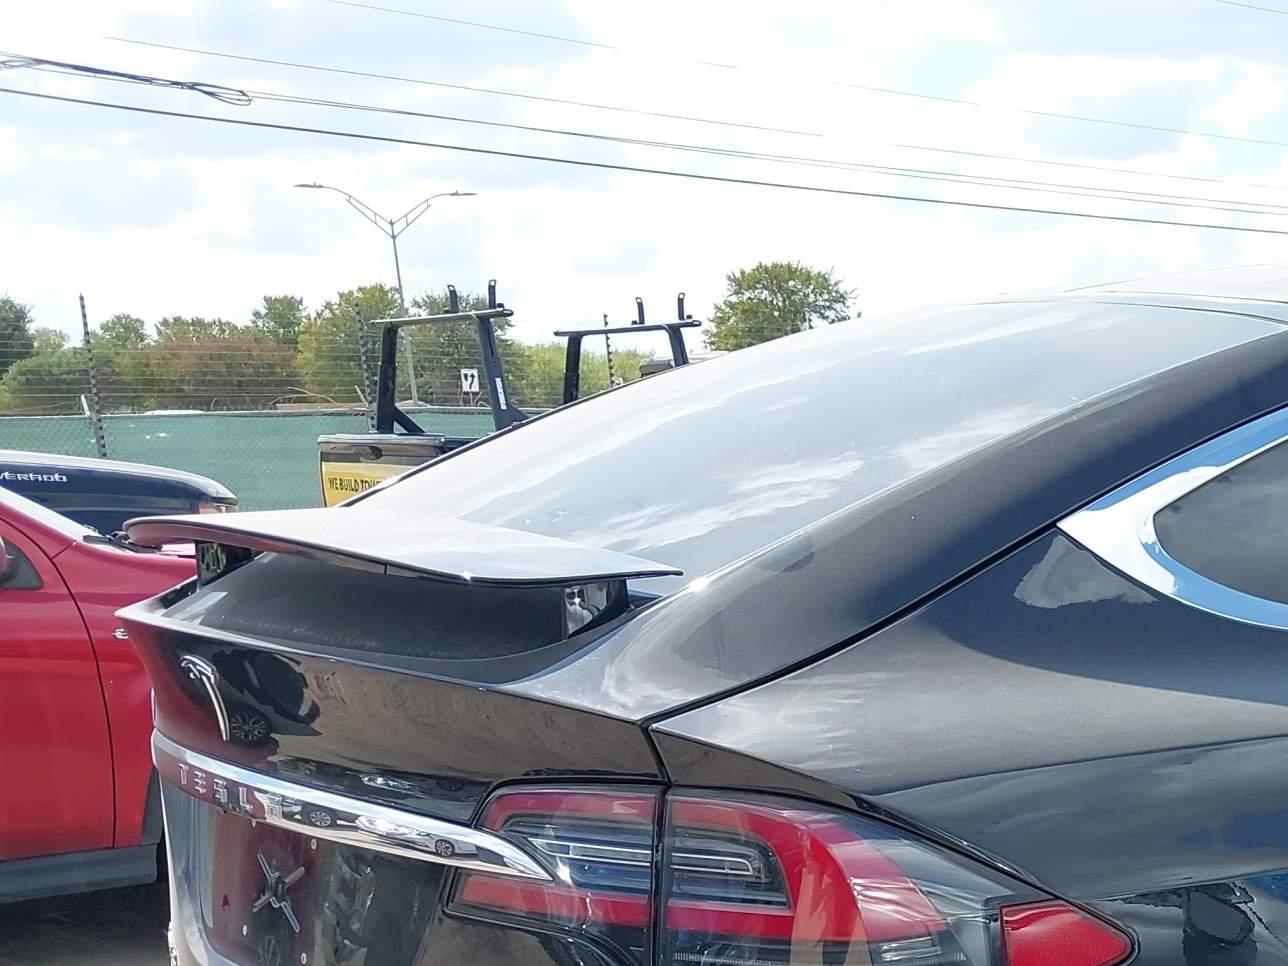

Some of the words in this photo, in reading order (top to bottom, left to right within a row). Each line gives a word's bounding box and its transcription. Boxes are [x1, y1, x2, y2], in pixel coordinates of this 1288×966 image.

[328, 477, 339, 490] WE
[340, 478, 360, 492] BUILD
[361, 480, 382, 491] TOU
[178, 763, 283, 820] TESLA
